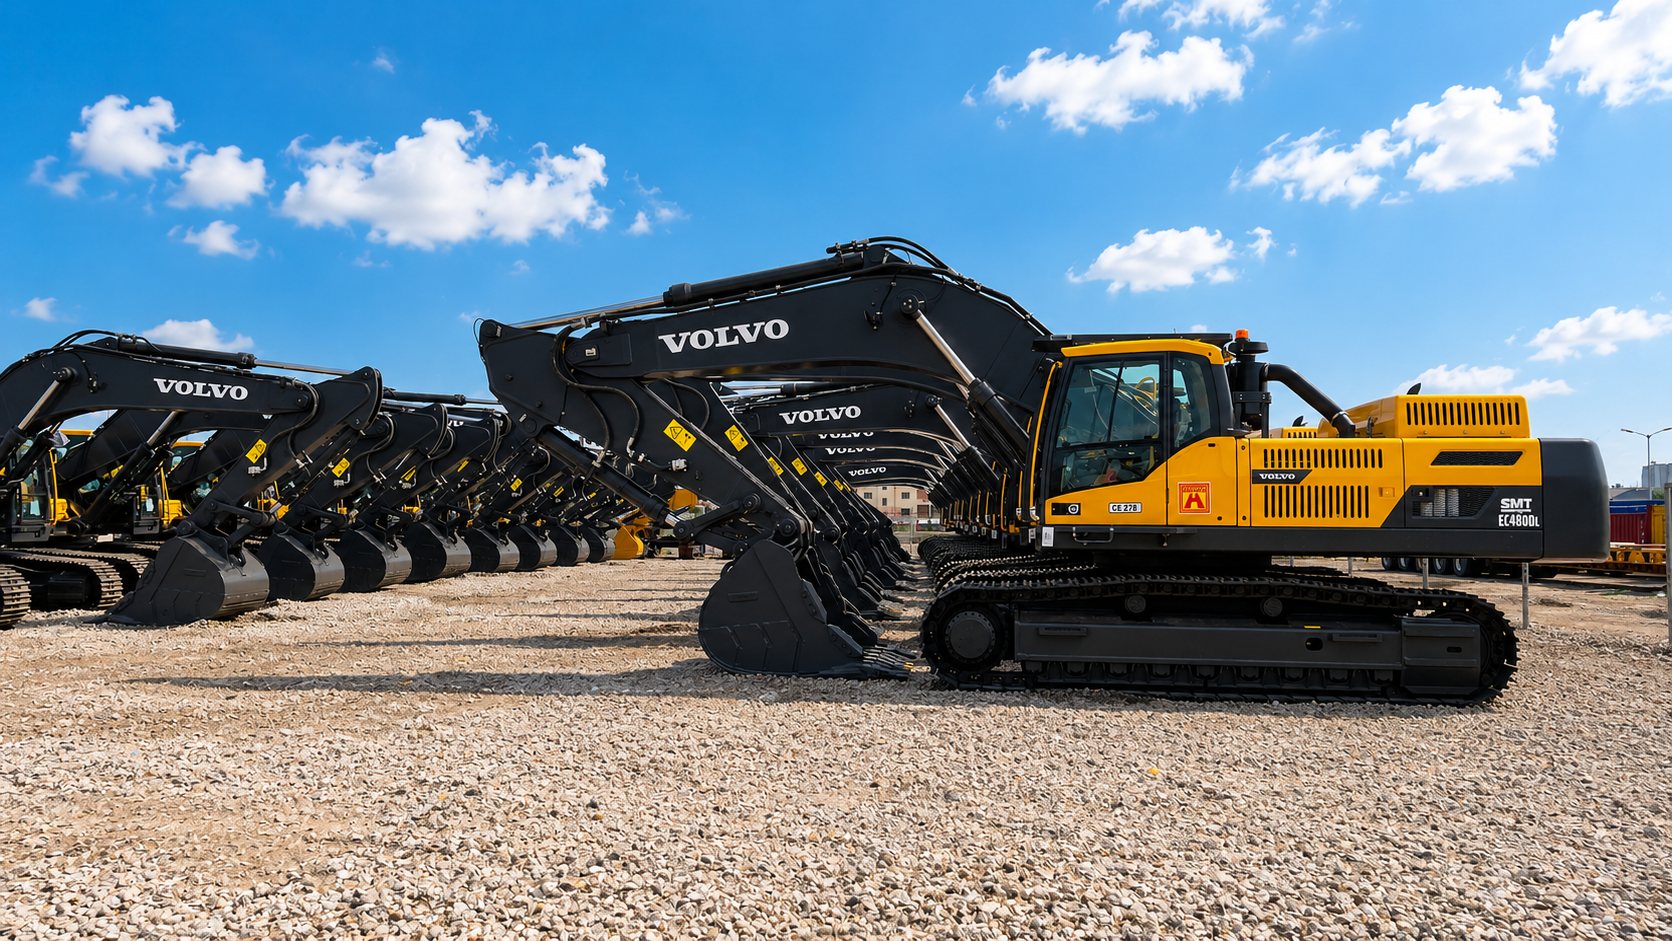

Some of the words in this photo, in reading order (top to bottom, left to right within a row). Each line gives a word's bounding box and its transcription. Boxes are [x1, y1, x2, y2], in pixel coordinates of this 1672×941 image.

[658, 319, 789, 353] VOLVO
[153, 378, 248, 400] VOLVO
[779, 405, 861, 425] VOLVO
[848, 466, 887, 477] VOLVO
[1112, 504, 1122, 512] CE
[1123, 504, 1138, 512] 278
[1500, 498, 1533, 509] SMT
[1498, 514, 1540, 527] EC480DL
